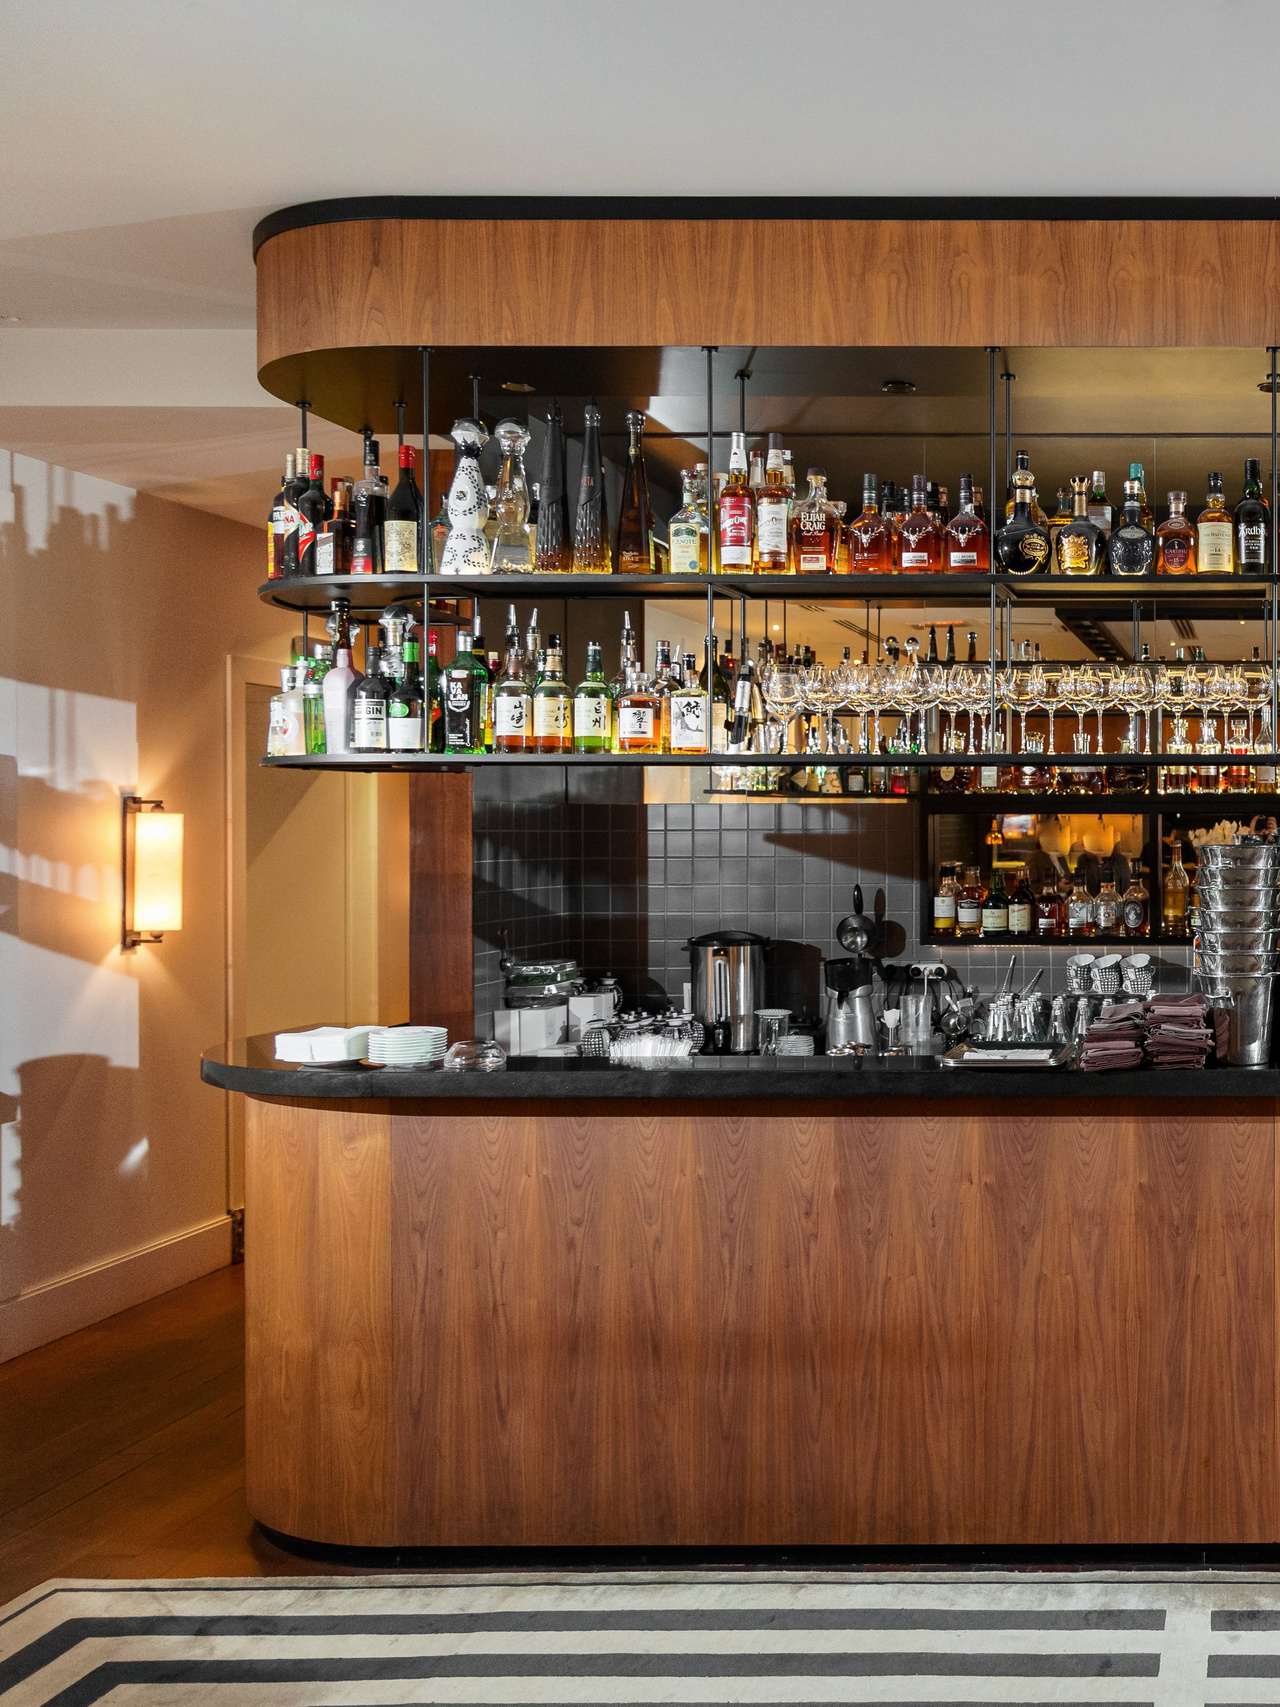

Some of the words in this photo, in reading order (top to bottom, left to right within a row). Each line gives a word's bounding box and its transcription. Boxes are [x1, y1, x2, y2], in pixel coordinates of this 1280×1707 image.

[801, 512, 826, 521] ELIJAH
[800, 521, 826, 531] CRAIG
[365, 706, 383, 715] GIN
